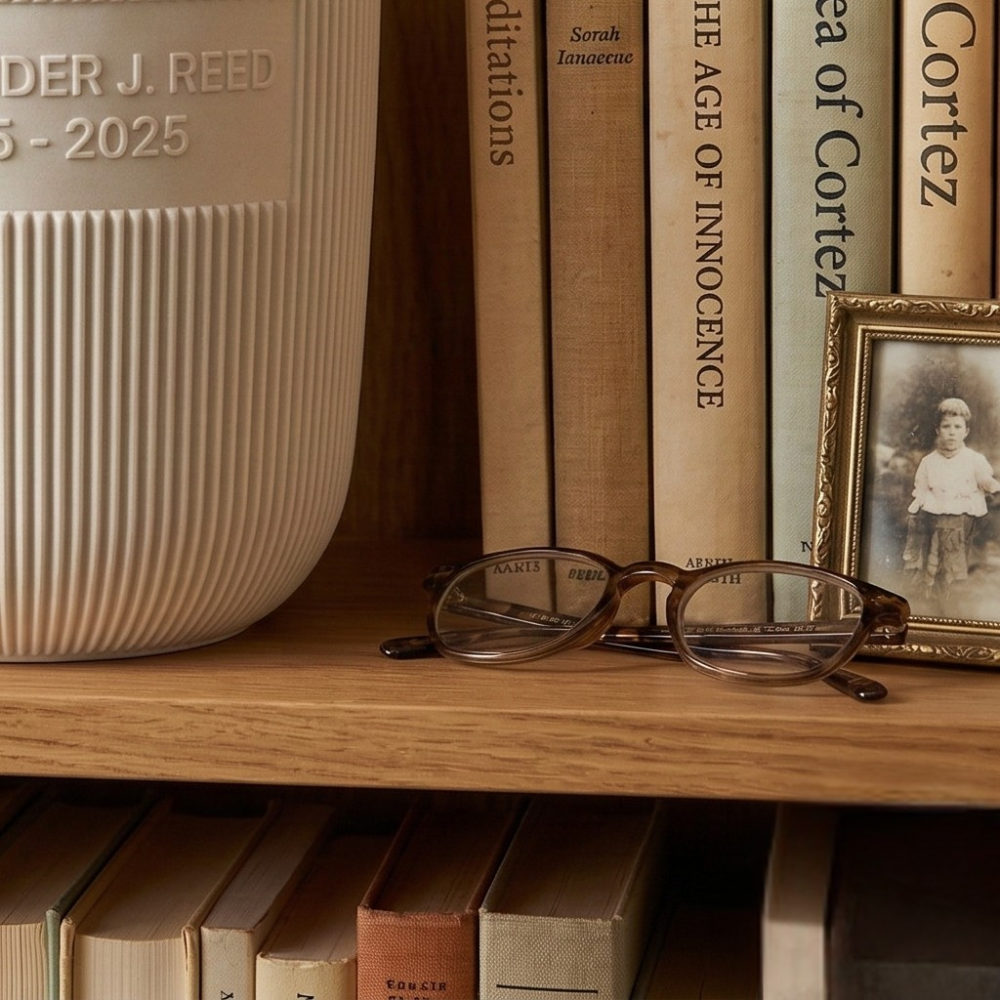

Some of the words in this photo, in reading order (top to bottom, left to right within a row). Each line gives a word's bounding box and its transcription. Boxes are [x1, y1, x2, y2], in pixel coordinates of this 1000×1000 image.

[116, 52, 156, 97] J.
[168, 48, 277, 95] REED
[694, 60, 723, 131] AGE
[814, 64, 864, 119] of
[919, 1, 977, 208] Cortez
[64, 114, 191, 161] 2025
[694, 143, 723, 190] OF
[813, 129, 861, 298] Cortez
[695, 202, 725, 410] INNOCENCE
